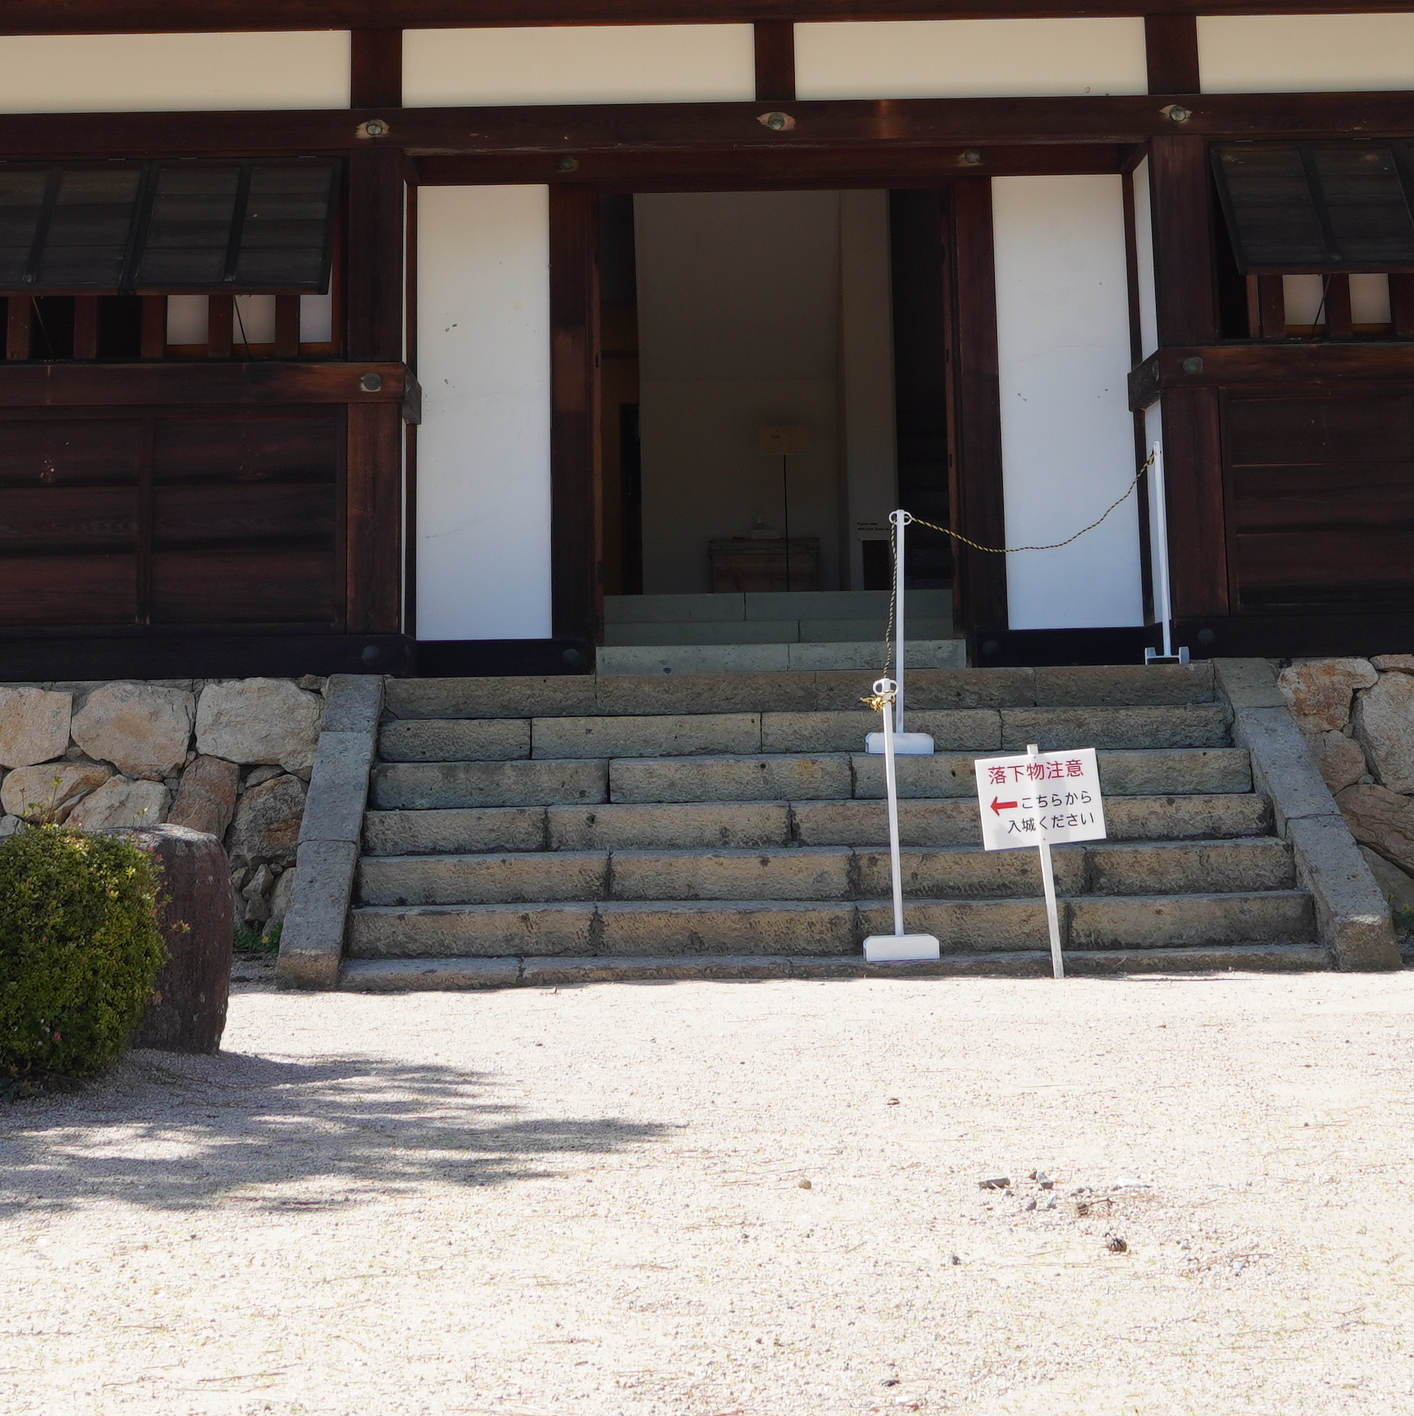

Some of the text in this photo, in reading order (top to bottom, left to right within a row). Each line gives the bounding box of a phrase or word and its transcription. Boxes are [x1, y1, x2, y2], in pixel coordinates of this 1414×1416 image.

[988, 759, 1084, 785] 落下物注意
[1021, 790, 1092, 809] こちらから
[1008, 812, 1095, 834] 入城ください
